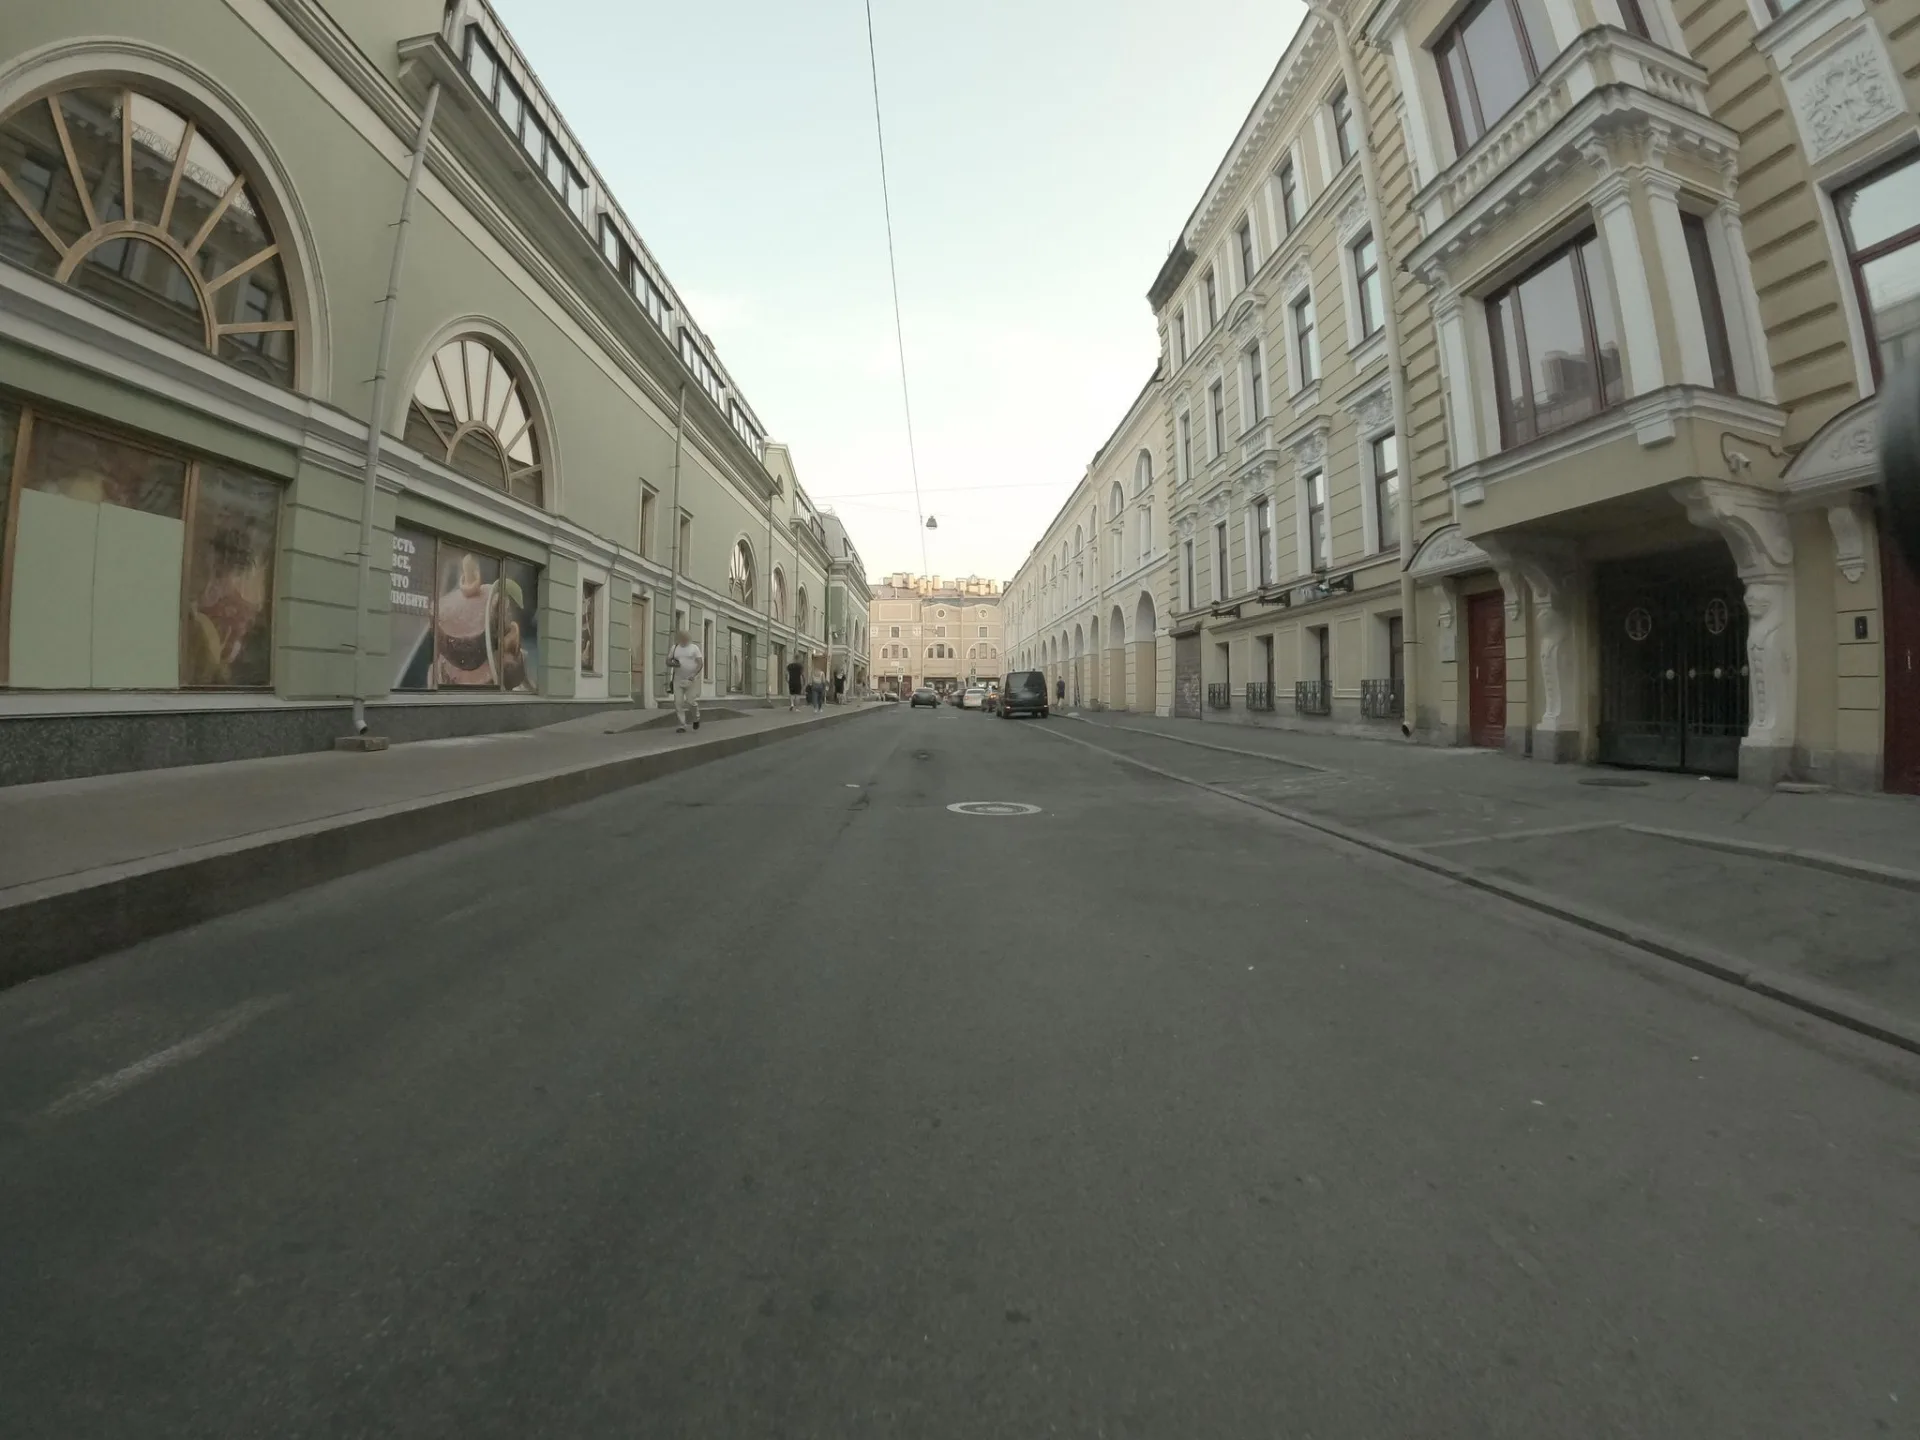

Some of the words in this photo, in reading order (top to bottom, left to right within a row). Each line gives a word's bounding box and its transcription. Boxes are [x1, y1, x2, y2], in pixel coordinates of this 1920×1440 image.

[393, 536, 415, 553] ЕСТЬ
[390, 573, 409, 588] ЧТО
[390, 590, 429, 608] ЛЮБИТЕ
